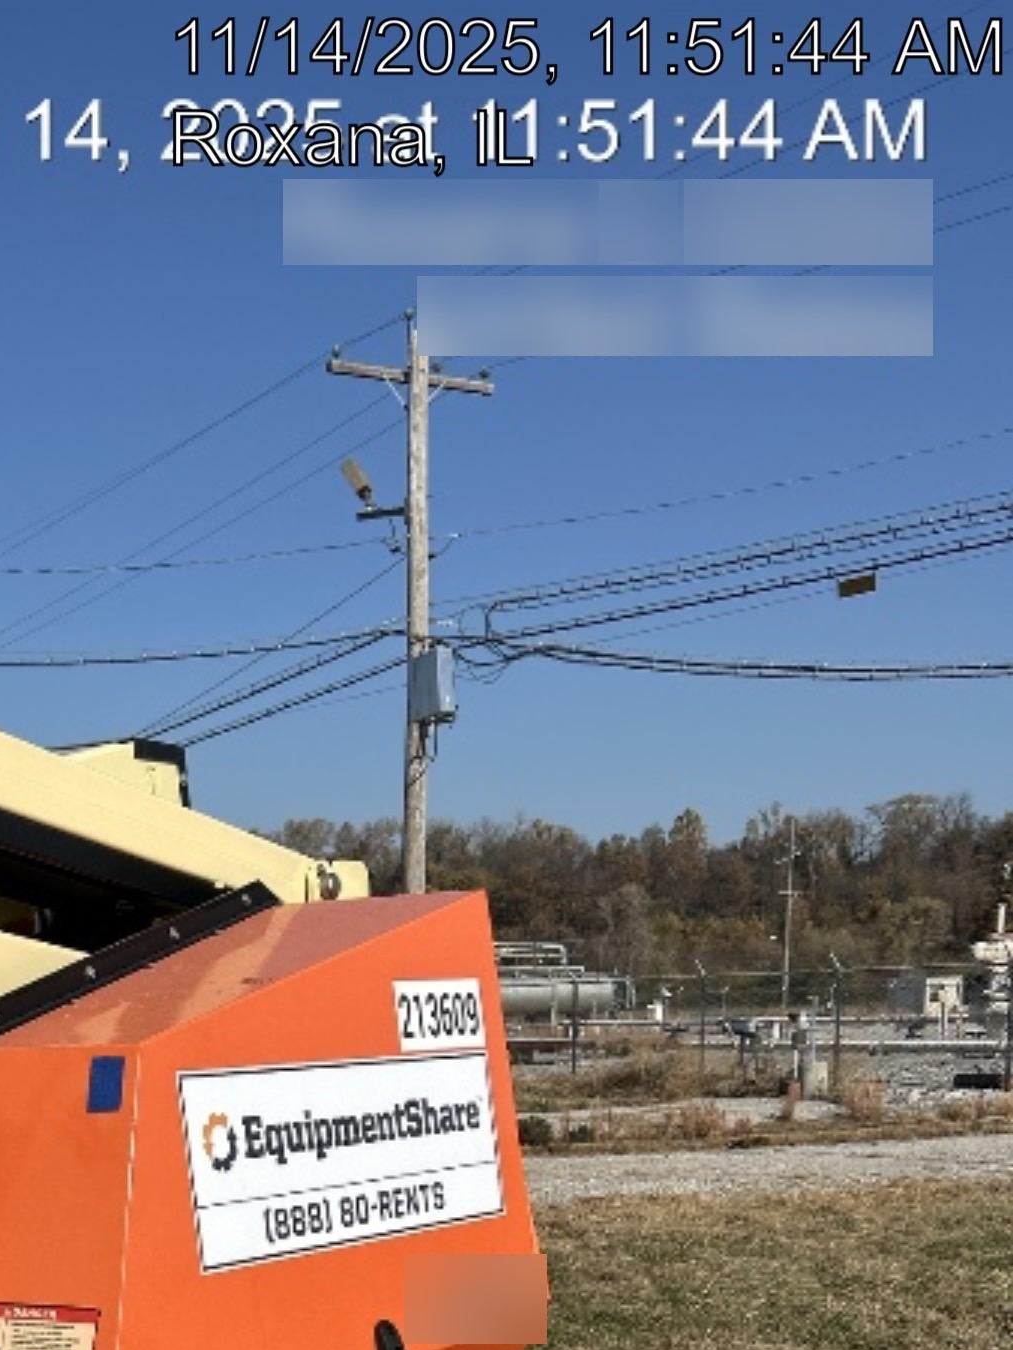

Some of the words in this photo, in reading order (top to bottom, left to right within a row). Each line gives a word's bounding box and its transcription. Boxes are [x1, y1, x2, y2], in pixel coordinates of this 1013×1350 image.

[398, 991, 481, 1039] 213609
[241, 1098, 480, 1164] EquipmentShare
[263, 1197, 334, 1245] (888)
[339, 1181, 446, 1228] 80-RENTS
